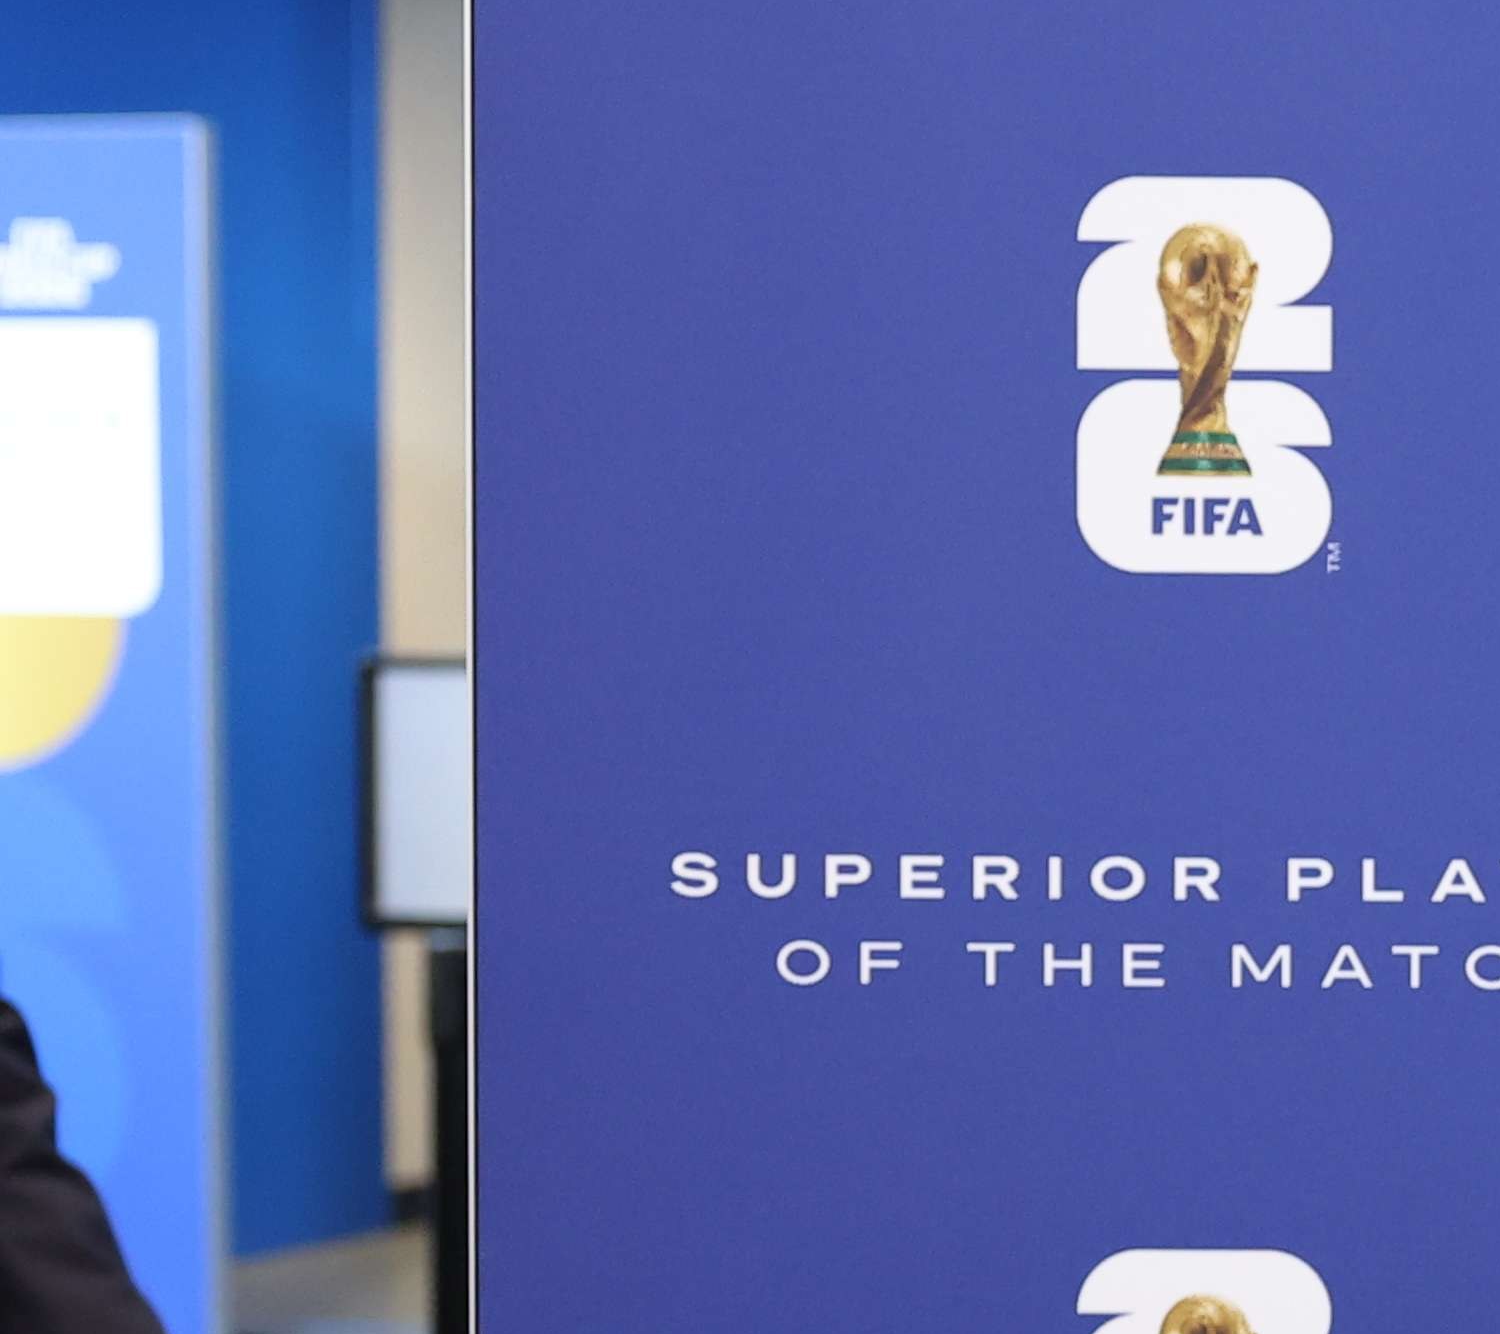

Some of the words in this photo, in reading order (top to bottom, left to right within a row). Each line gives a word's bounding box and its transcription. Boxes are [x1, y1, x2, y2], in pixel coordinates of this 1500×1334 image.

[1151, 495, 1263, 537] FIFA
[669, 851, 1222, 902] SUPERIOR
[775, 938, 904, 986] OF
[965, 941, 1167, 988] THE
